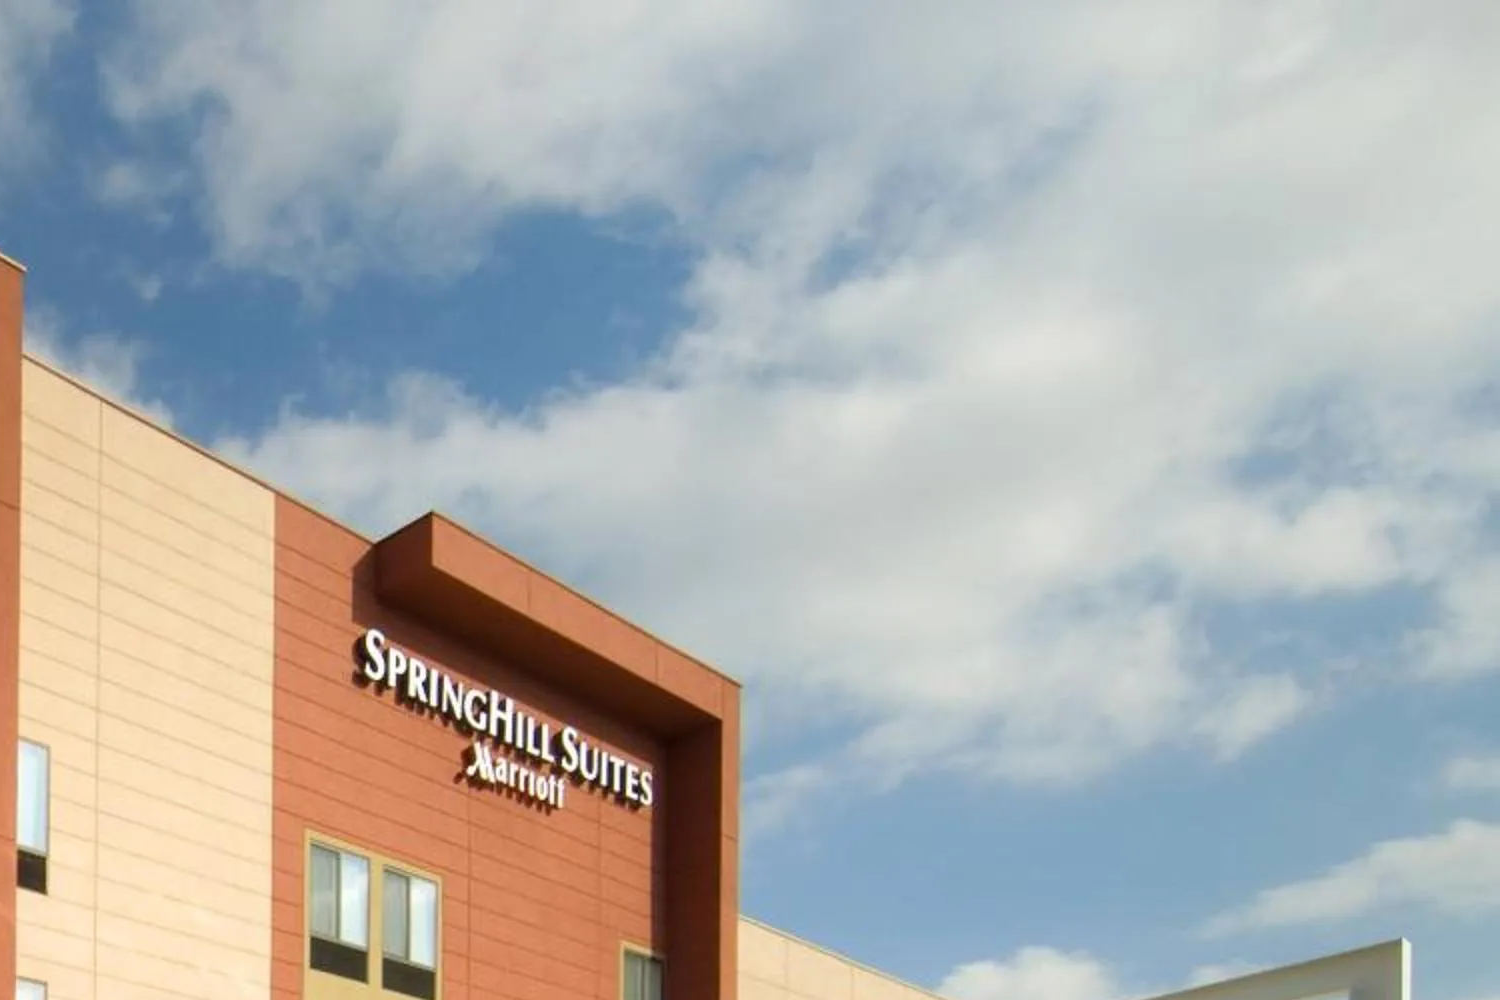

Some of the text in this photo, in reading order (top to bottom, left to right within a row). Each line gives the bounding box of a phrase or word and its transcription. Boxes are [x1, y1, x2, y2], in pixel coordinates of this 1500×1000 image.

[363, 627, 653, 806] SPRINGHILL SUITES
[466, 741, 565, 809] Marriott
